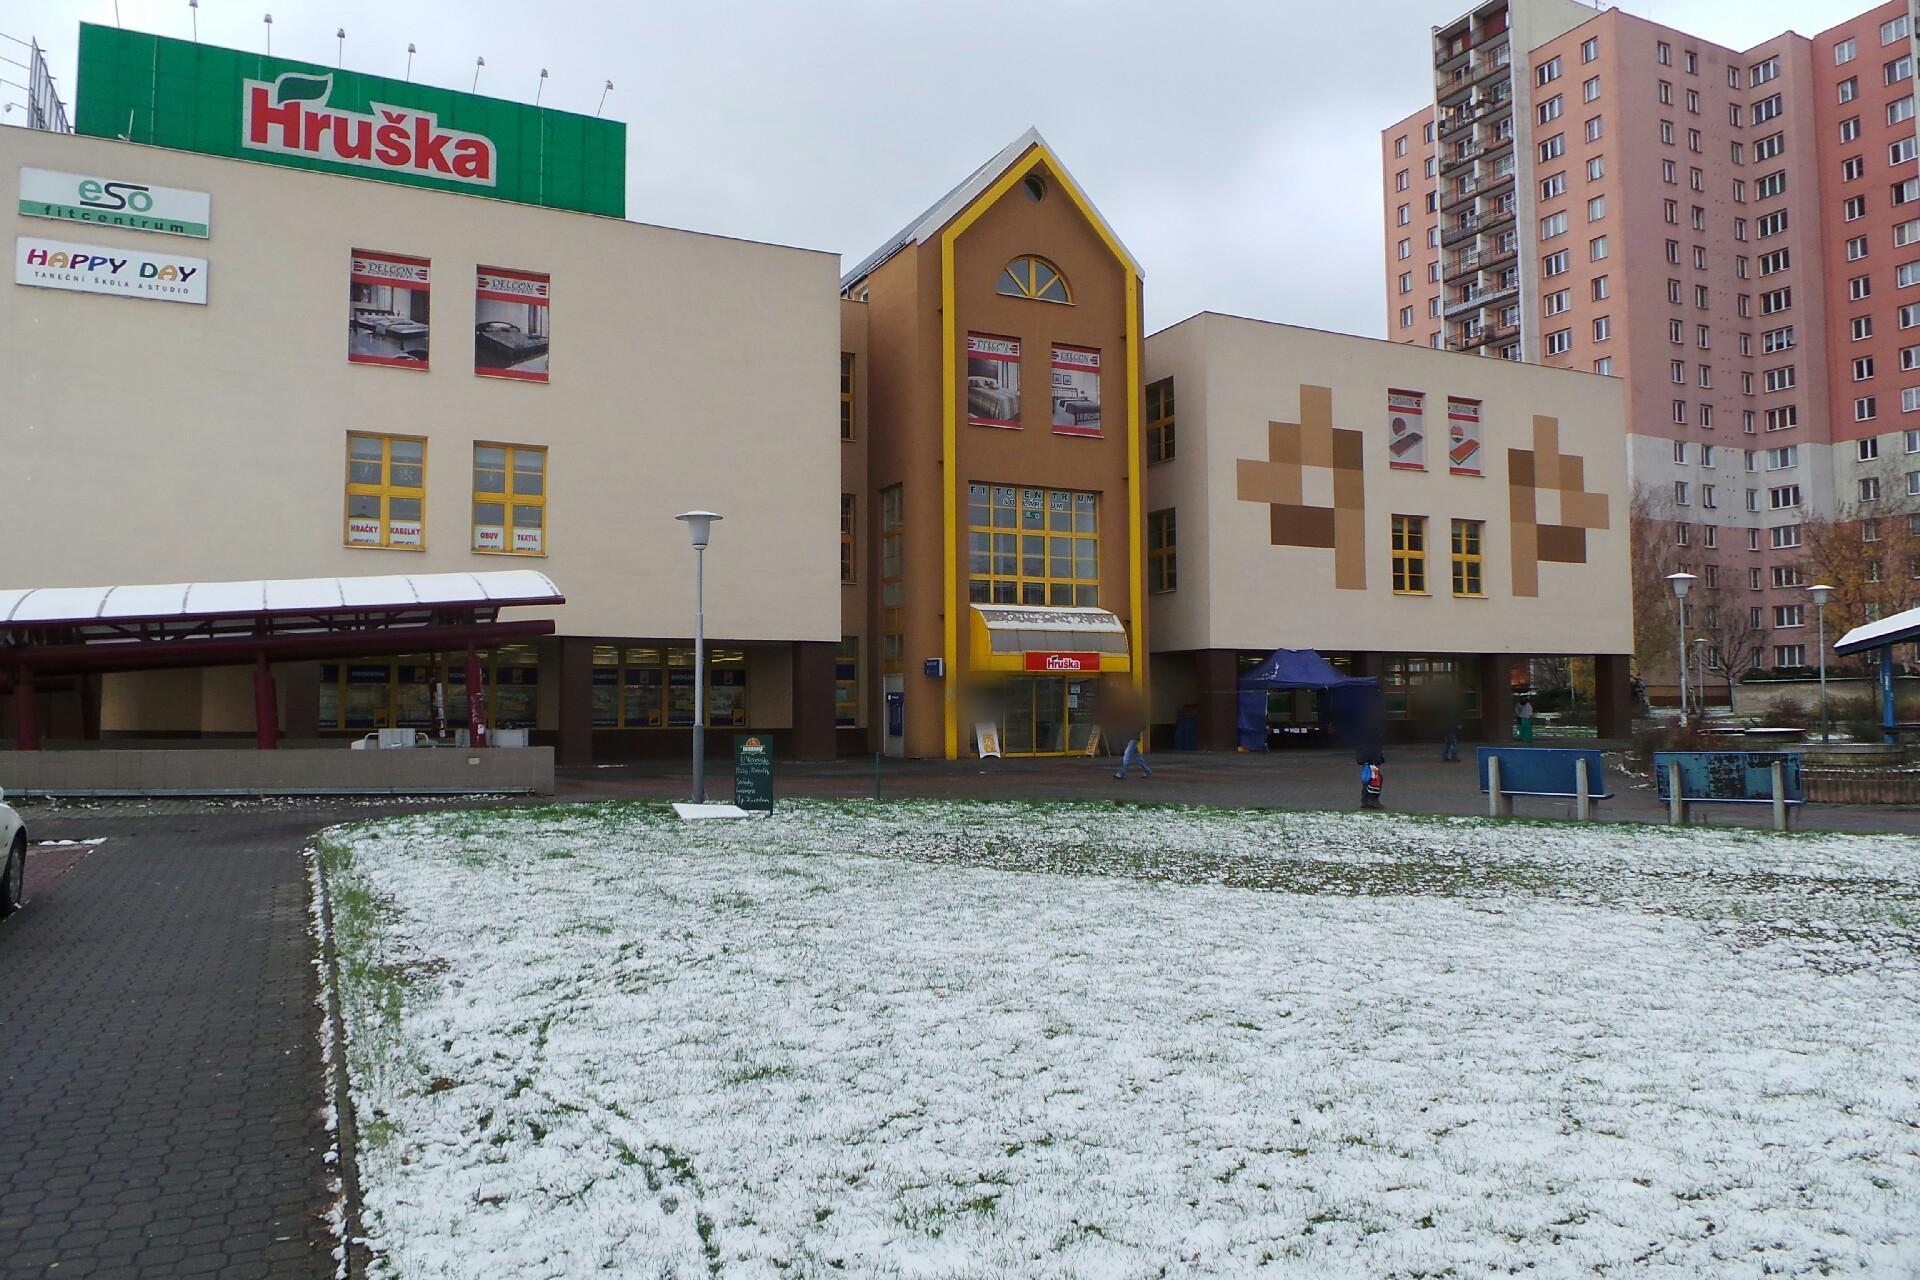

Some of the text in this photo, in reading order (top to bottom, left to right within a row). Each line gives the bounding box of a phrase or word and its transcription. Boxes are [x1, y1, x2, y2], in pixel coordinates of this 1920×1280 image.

[251, 87, 490, 180] Hruška
[44, 205, 184, 233] fitcentrum
[27, 249, 197, 283] HAPPY DAY
[367, 262, 414, 276] DELCON
[147, 283, 189, 294] STUDIO
[491, 278, 535, 292] DELCON
[350, 524, 378, 534] HRAČKY
[390, 527, 421, 536] KABELKY
[480, 531, 499, 540] OBUV
[517, 533, 538, 542] TEXTIL
[1048, 658, 1080, 668] Hruška
